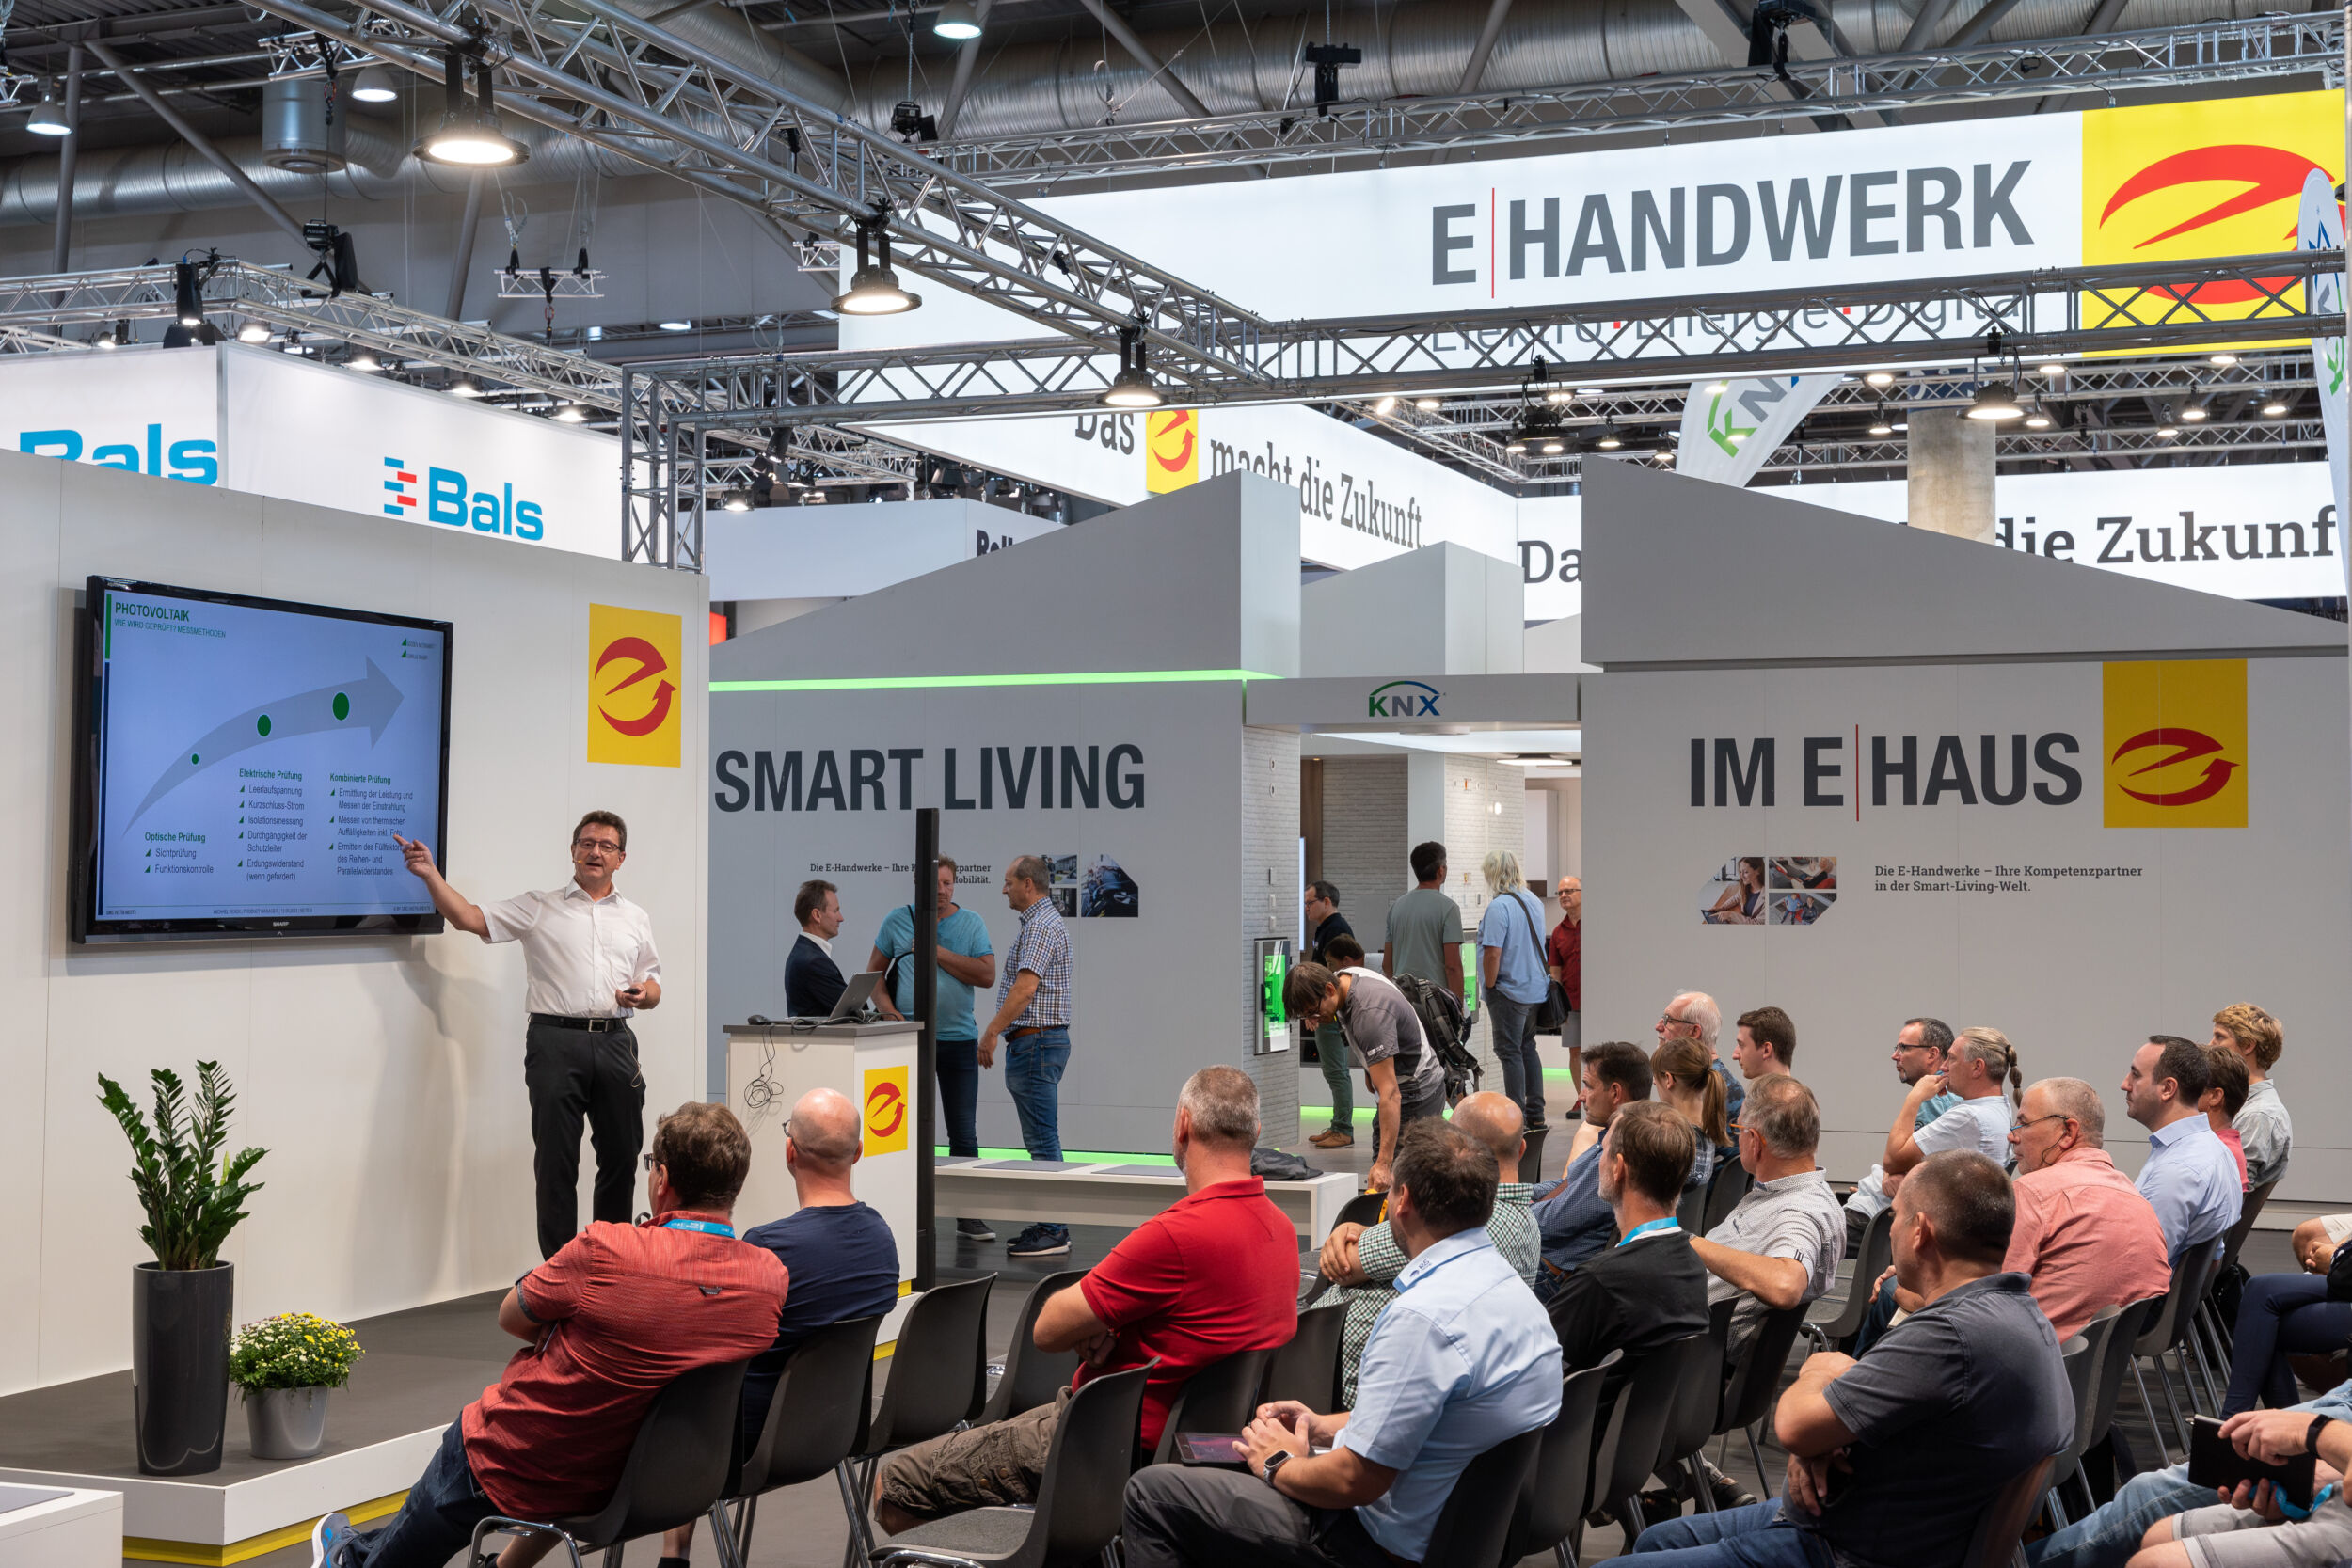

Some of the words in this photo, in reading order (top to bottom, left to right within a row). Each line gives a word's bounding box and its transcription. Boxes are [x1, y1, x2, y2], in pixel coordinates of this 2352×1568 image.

[1509, 159, 2034, 281] HANDWERK
[1299, 455, 1334, 522] die
[428, 466, 544, 541] Bals
[1517, 540, 1582, 584] Da
[2096, 504, 2337, 564] Zukunf
[115, 602, 190, 622] PHOTOVOLTAIK
[114, 618, 127, 627] WIE
[128, 620, 144, 629] WIRD
[177, 626, 227, 638] MESSMETHODEN
[1368, 695, 1441, 718] KNX
[239, 768, 276, 779] Elektrische
[277, 770, 303, 782] Prüfung
[1690, 737, 1776, 807] IM
[1871, 732, 2083, 807] HAUS
[329, 773, 366, 783] Kombinierte
[367, 774, 391, 785] Prüfung
[714, 748, 924, 813] SMART
[944, 743, 1146, 811] LIVING
[248, 785, 303, 797] Leerlaufspannung
[368, 789, 378, 799] der
[248, 800, 305, 810] Kurzschluss-Strom
[361, 801, 372, 810] der
[247, 816, 304, 827] Isolationsmessung
[144, 832, 177, 843] Optische
[178, 832, 206, 843] Prüfung
[297, 832, 308, 840] der
[155, 848, 197, 860] Sichtprüfung
[246, 844, 283, 853] Schutzleiter
[154, 863, 215, 874] Funktionskontrolle
[246, 859, 305, 870] Erdungswiderstand
[809, 863, 824, 872] Die
[825, 863, 882, 873] E-Handwerke
[892, 863, 910, 873] Ihre
[1875, 865, 1895, 877] Die
[1898, 865, 1980, 877] E-Handwerke
[1995, 865, 2021, 877] Ihre
[2024, 865, 2143, 879] Kompetenzpartner
[1875, 880, 1887, 892] in
[1889, 880, 1911, 892] der
[1913, 880, 2031, 894] Smart-Living-Welt.
